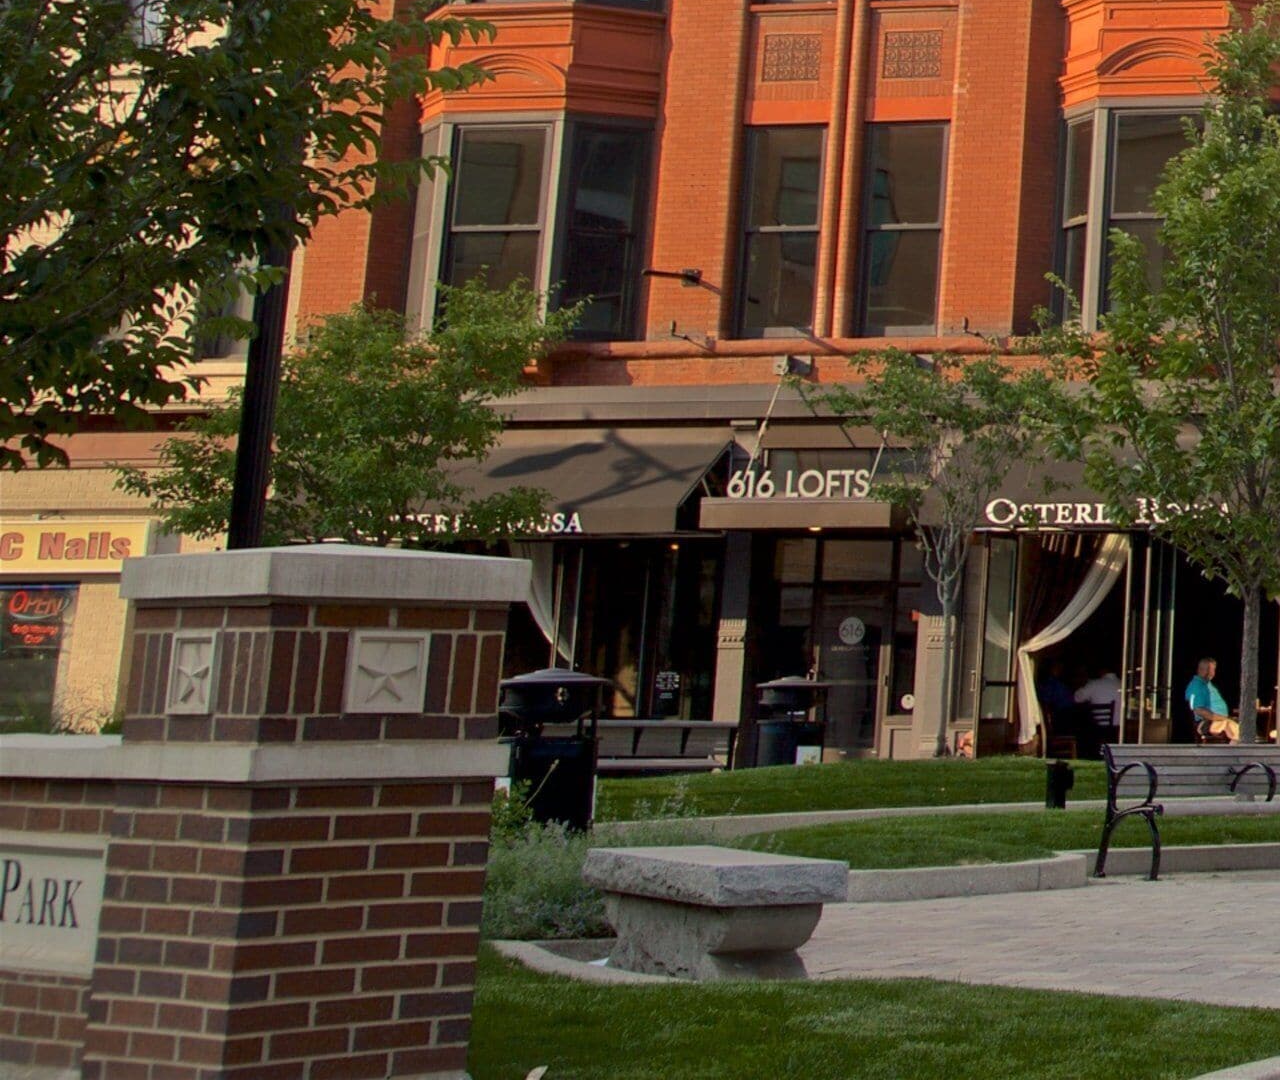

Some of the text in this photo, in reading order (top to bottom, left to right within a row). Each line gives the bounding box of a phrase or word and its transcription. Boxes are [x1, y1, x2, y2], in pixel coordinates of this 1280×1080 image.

[727, 469, 870, 498] 616 LOFTS
[38, 532, 131, 560] Nails
[0, 859, 82, 928] PARK
